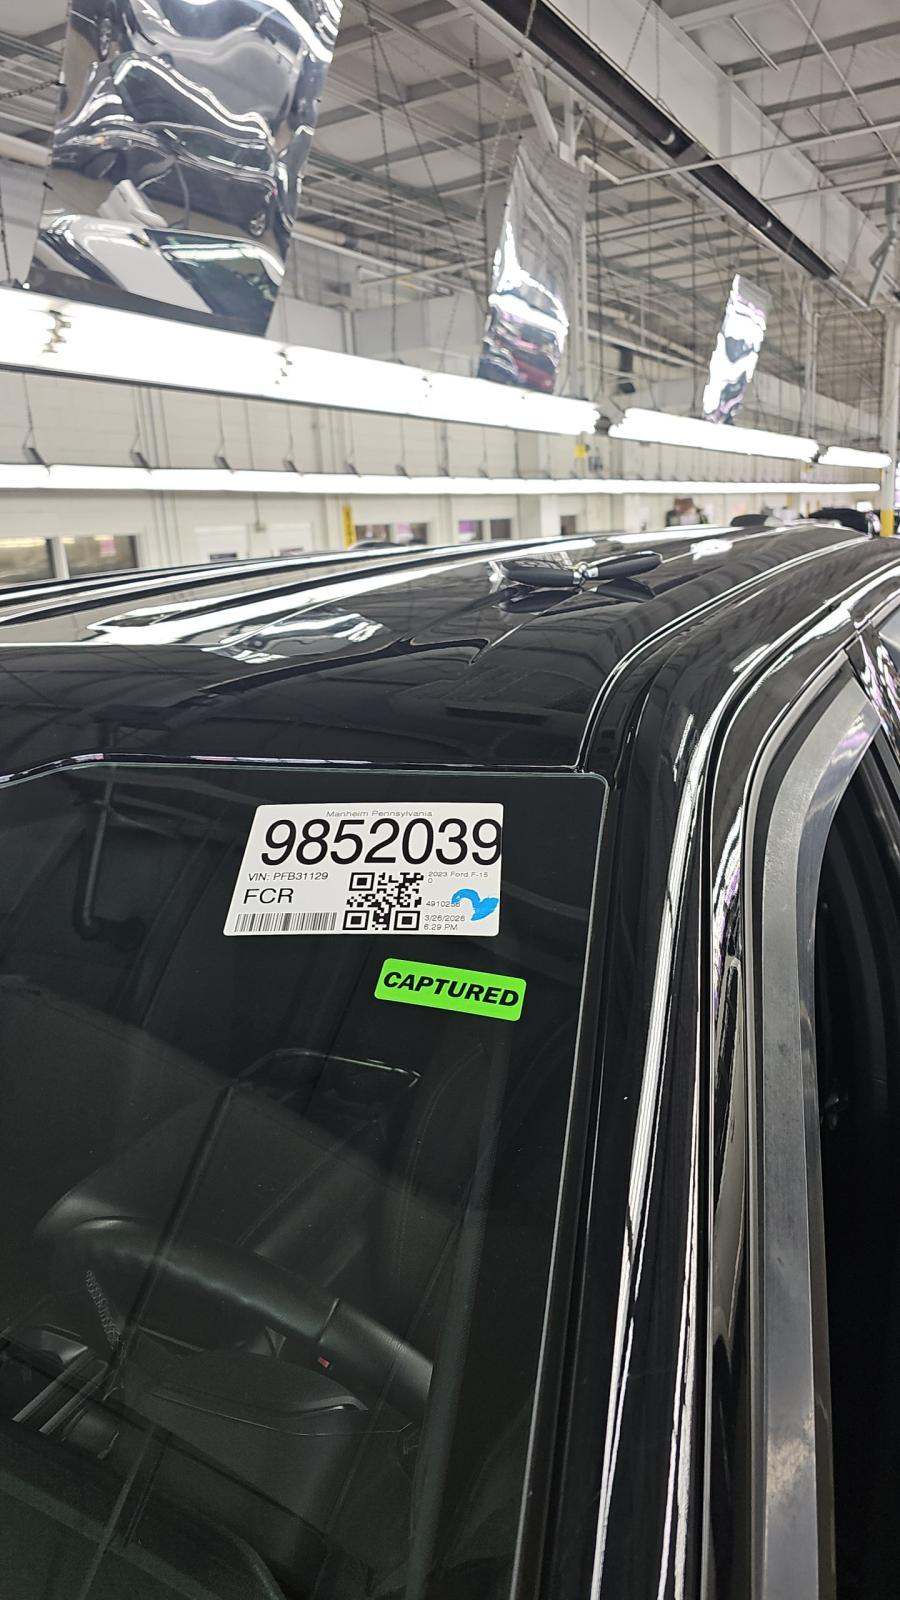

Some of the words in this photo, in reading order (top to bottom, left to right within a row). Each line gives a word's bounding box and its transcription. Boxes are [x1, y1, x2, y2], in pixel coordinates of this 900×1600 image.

[372, 810, 433, 818] Pennsylvania
[261, 818, 502, 866] 9852039
[248, 872, 271, 882] VIN:
[272, 872, 329, 881] PFB31129
[243, 888, 294, 904] FCR
[383, 971, 519, 1007] CAPTURED
